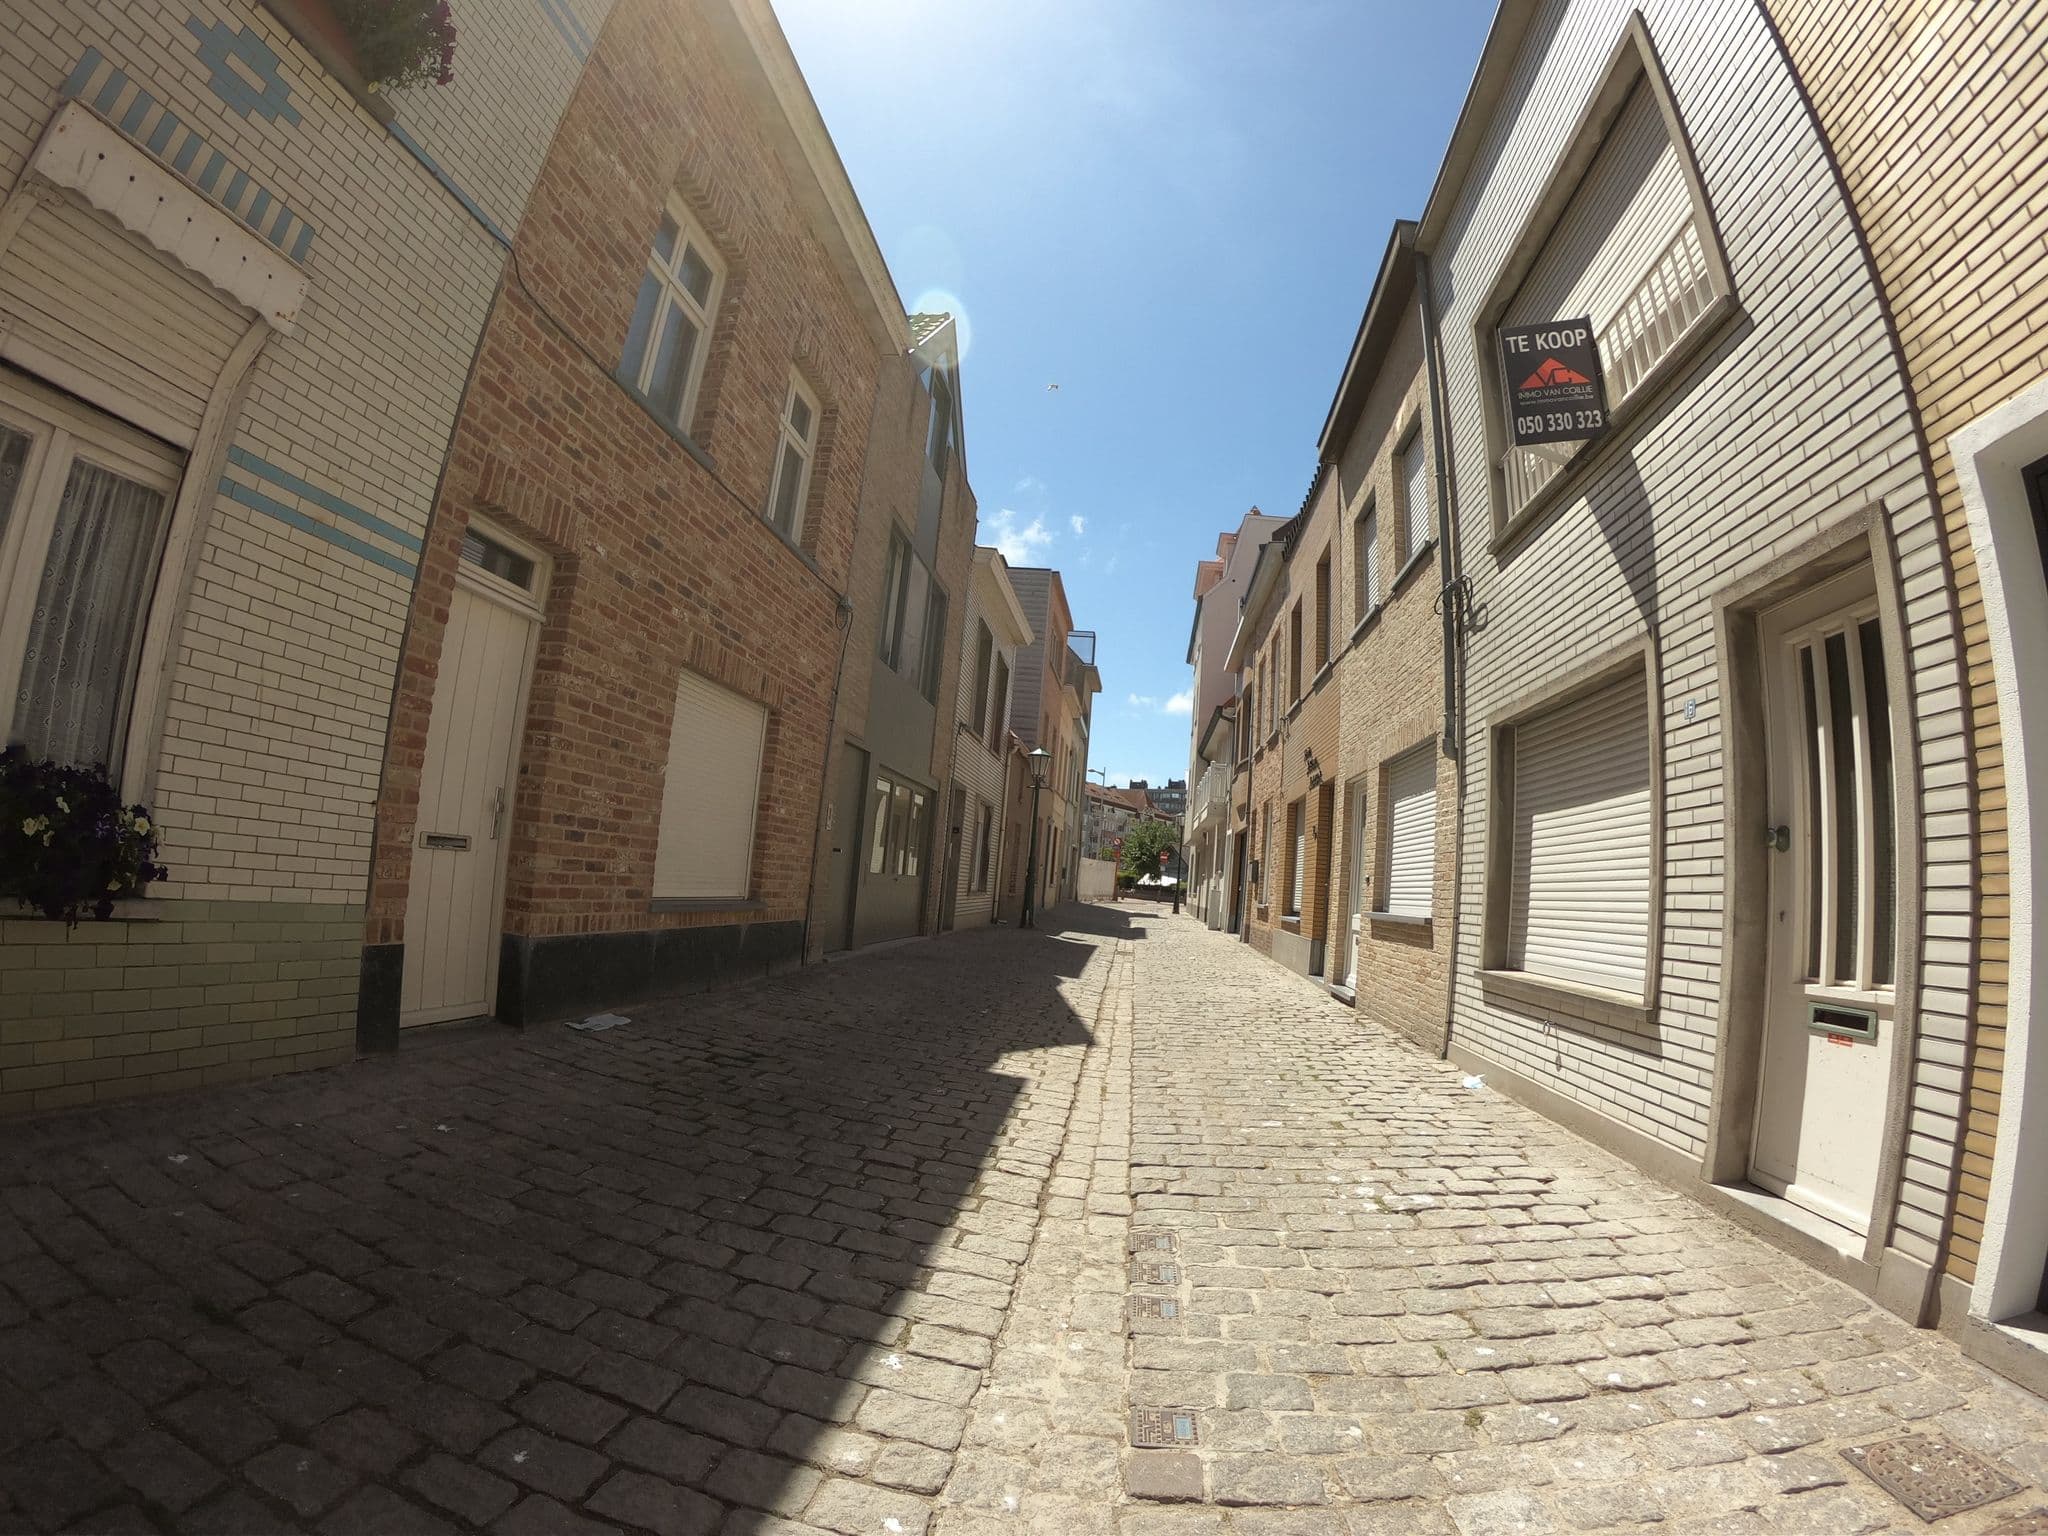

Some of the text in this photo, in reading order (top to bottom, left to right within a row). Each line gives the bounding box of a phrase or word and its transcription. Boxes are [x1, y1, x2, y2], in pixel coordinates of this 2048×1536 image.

[1505, 329, 1587, 353] TE KOOP
[1544, 388, 1561, 396] VAN
[1517, 409, 1602, 435] 050 330 323
